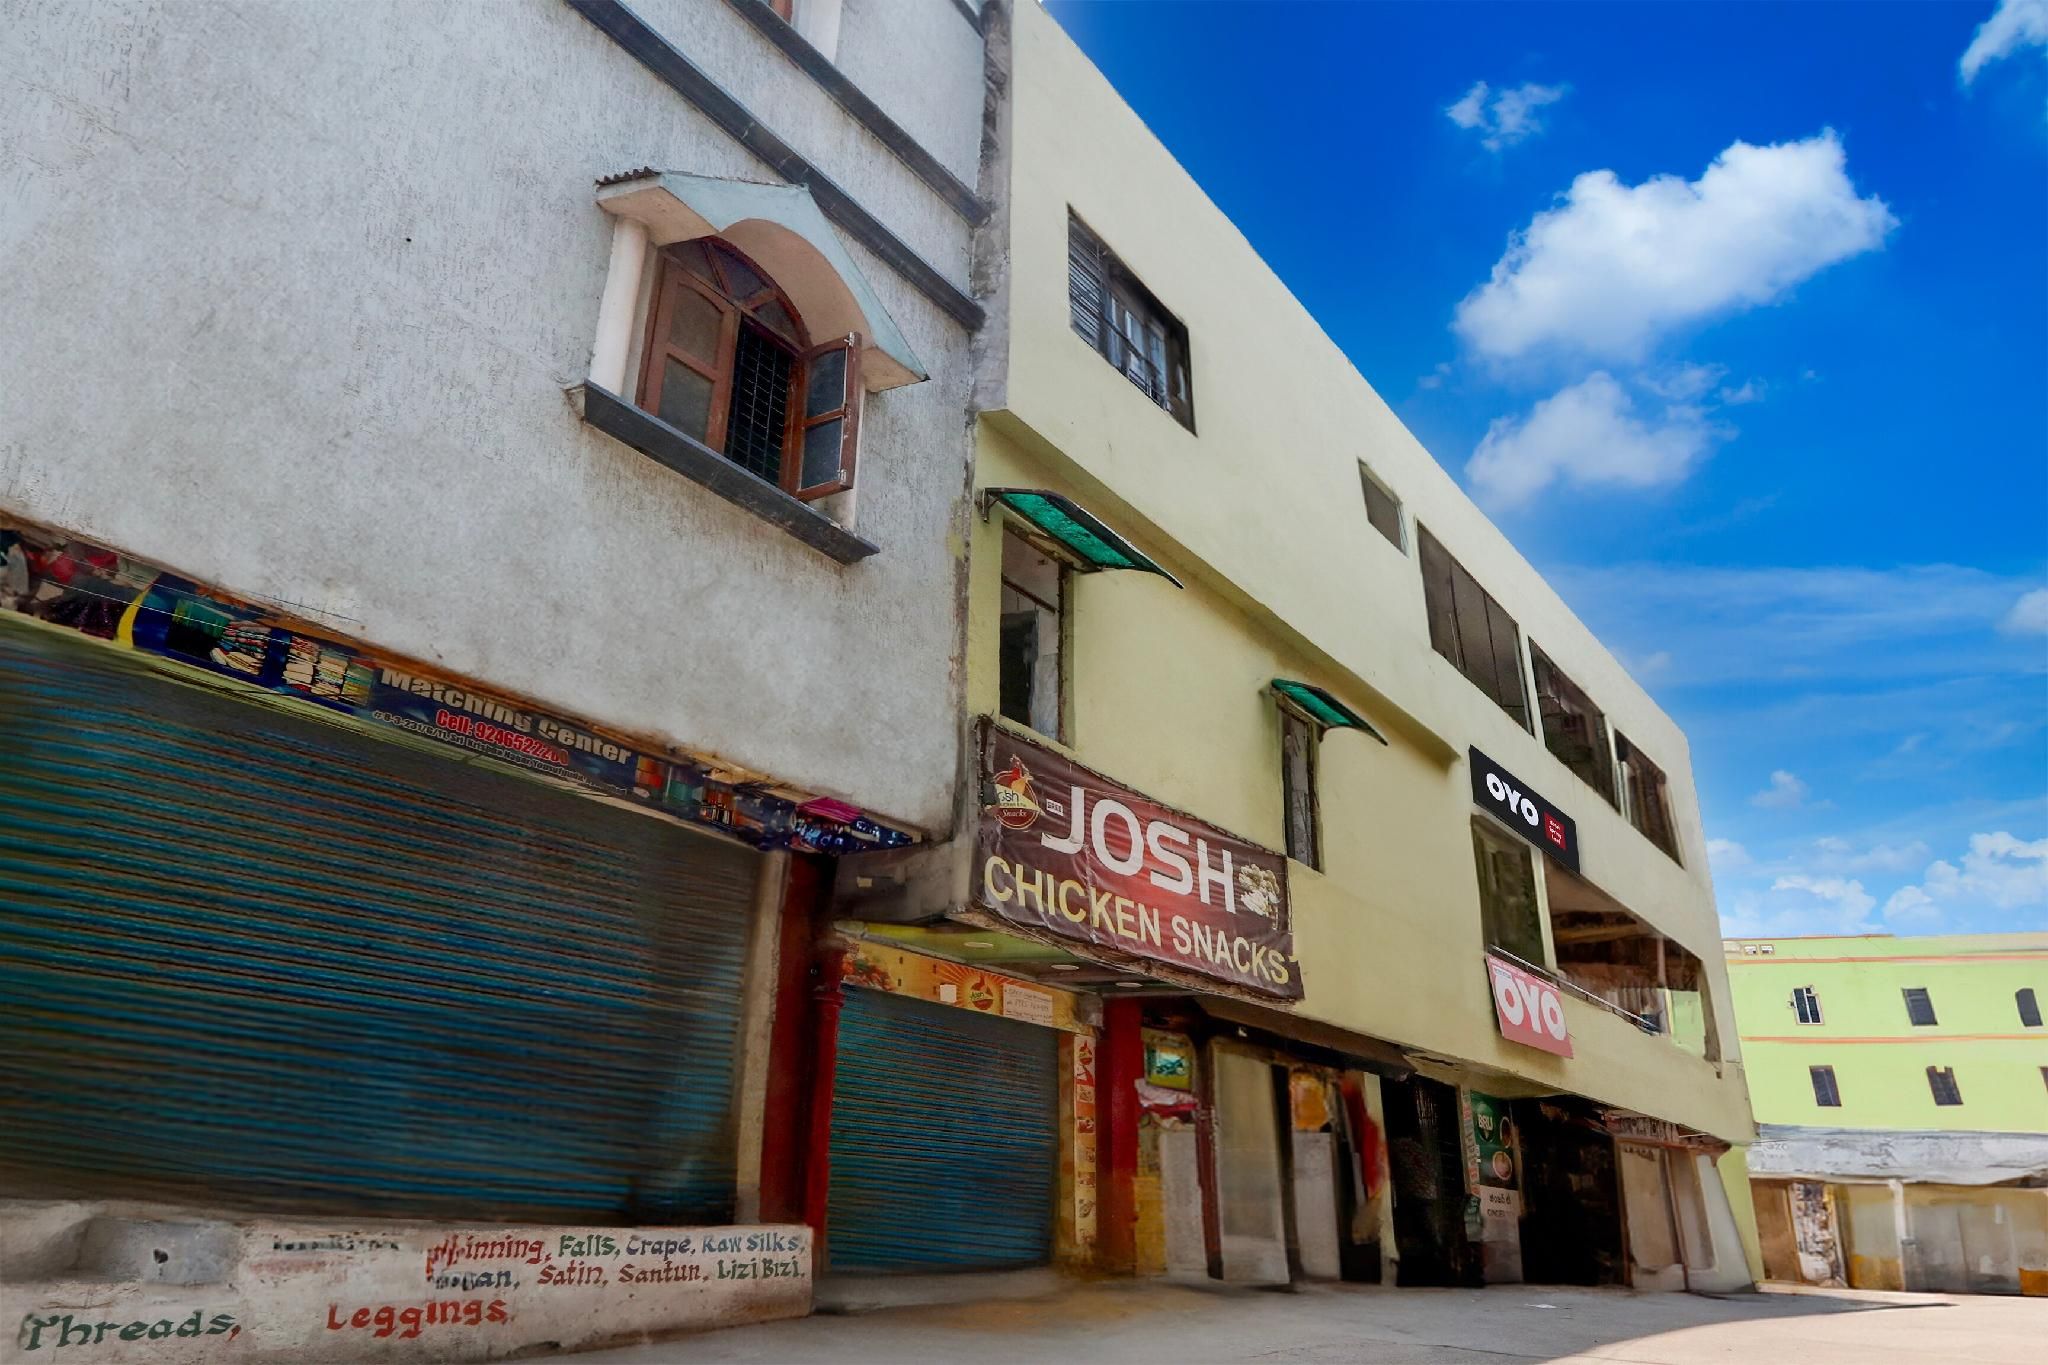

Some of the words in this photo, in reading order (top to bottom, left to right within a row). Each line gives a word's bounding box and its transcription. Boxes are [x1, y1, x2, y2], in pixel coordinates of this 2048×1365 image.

[381, 667, 532, 733] Matching
[538, 719, 631, 764] Center
[436, 709, 474, 737] Cell:
[1486, 773, 1539, 827] OYO
[1041, 786, 1237, 914] JOSH
[984, 855, 1162, 948] CHICKEN
[1171, 915, 1290, 985] SNACKS
[1495, 974, 1567, 1041] OYO
[537, 1259, 609, 1288] Satin,
[617, 1260, 709, 1284] Santun,
[717, 1258, 758, 1280] Lizi
[558, 1234, 621, 1260] Falls,
[18, 1308, 242, 1351] Threads,
